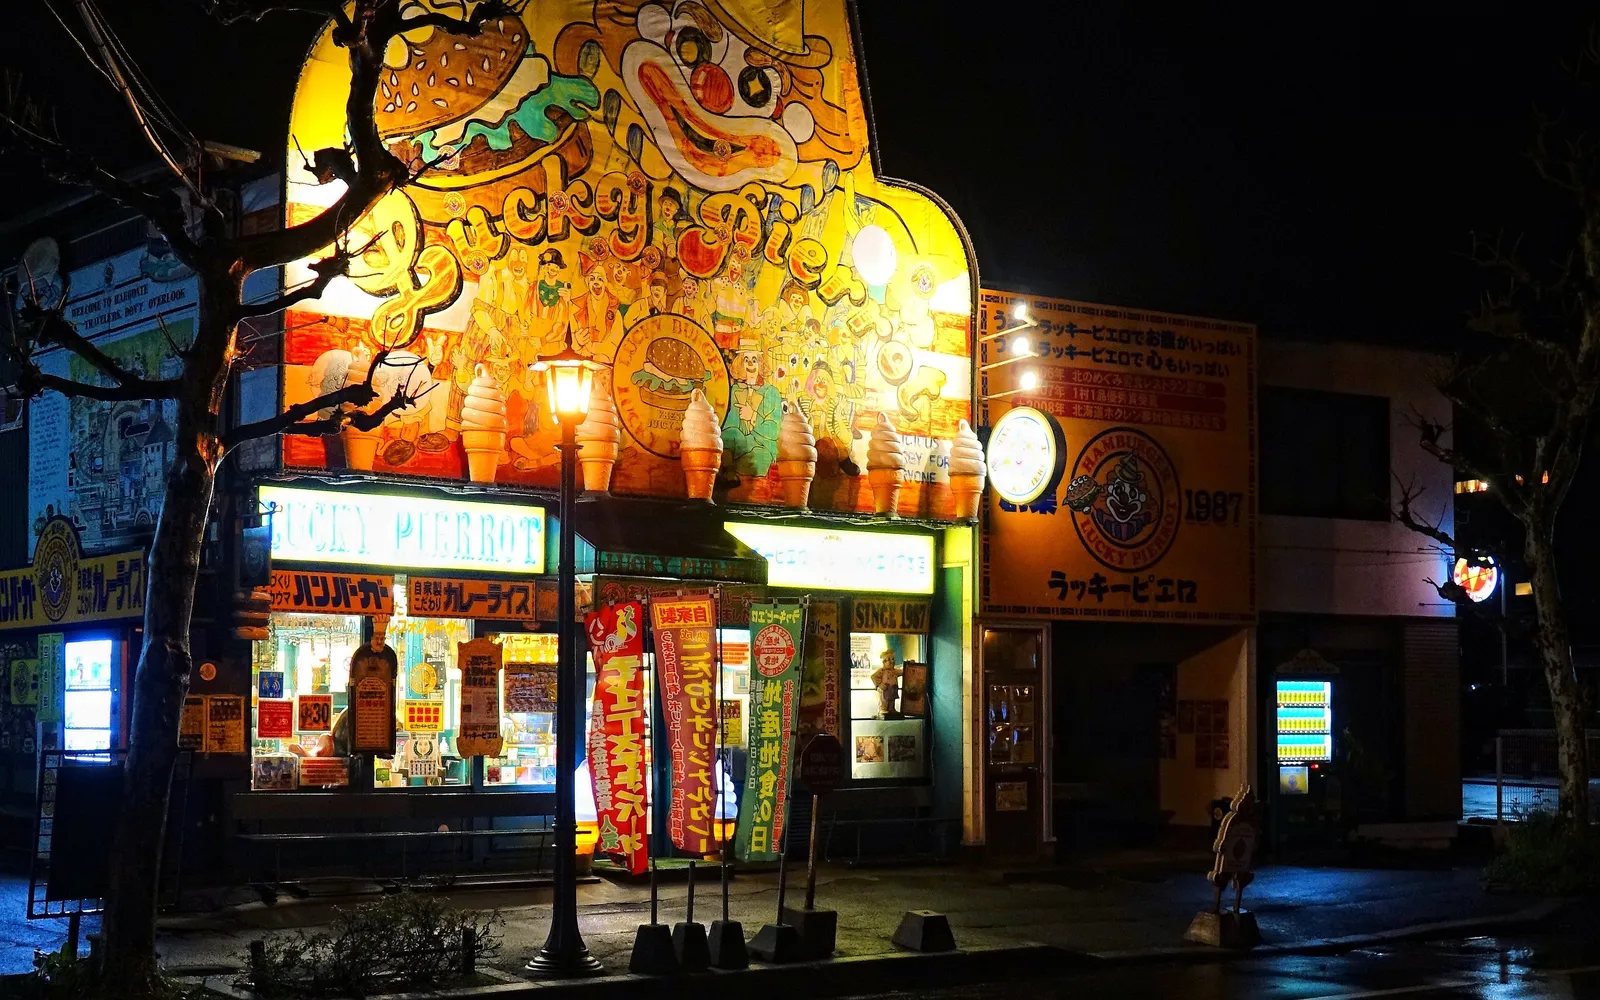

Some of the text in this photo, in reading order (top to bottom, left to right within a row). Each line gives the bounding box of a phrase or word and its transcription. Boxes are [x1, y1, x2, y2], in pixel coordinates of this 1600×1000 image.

[341, 155, 654, 348] Lucky
[103, 298, 112, 309] TO
[148, 288, 185, 309] OVERLOOK
[619, 319, 661, 367] LUCKY
[1082, 435, 1171, 481] HAMBURGER
[1185, 489, 1244, 525] 1987
[395, 508, 542, 565] PIERROT
[1081, 498, 1177, 567] LUCKY PIERROT
[93, 558, 142, 613] カレーライス
[269, 591, 290, 606] カウマ
[294, 574, 389, 610] ハンバーガー
[414, 581, 442, 597] 自家製
[443, 581, 531, 615] カレーライス
[1048, 571, 1197, 603] ラッキーピエロ
[414, 599, 441, 612] こだわり
[856, 603, 896, 628] SINCE
